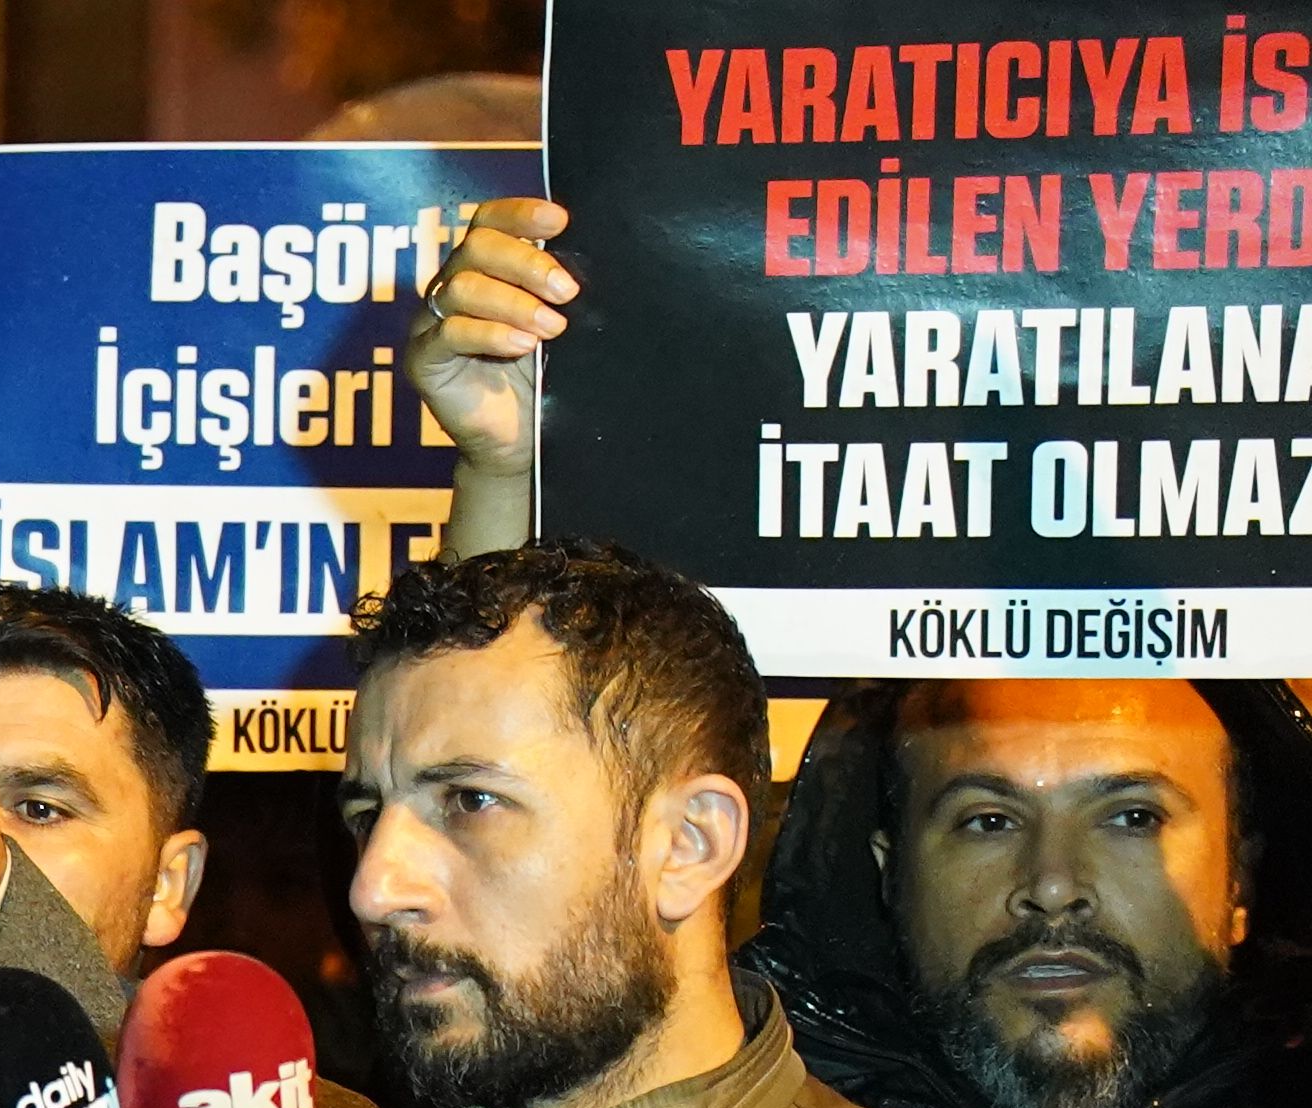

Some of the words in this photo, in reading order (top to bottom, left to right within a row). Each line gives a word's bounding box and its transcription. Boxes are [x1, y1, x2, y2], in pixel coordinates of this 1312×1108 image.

[665, 36, 1193, 146] YARATICIYA
[764, 158, 1062, 277] EDİLEN
[94, 326, 394, 471] İçişleri
[758, 423, 1007, 538] İTAAT
[889, 600, 1032, 659] KÖKLÜ
[1045, 599, 1229, 667] DEĞİŞİM
[233, 699, 352, 755] KÖKLÜ
